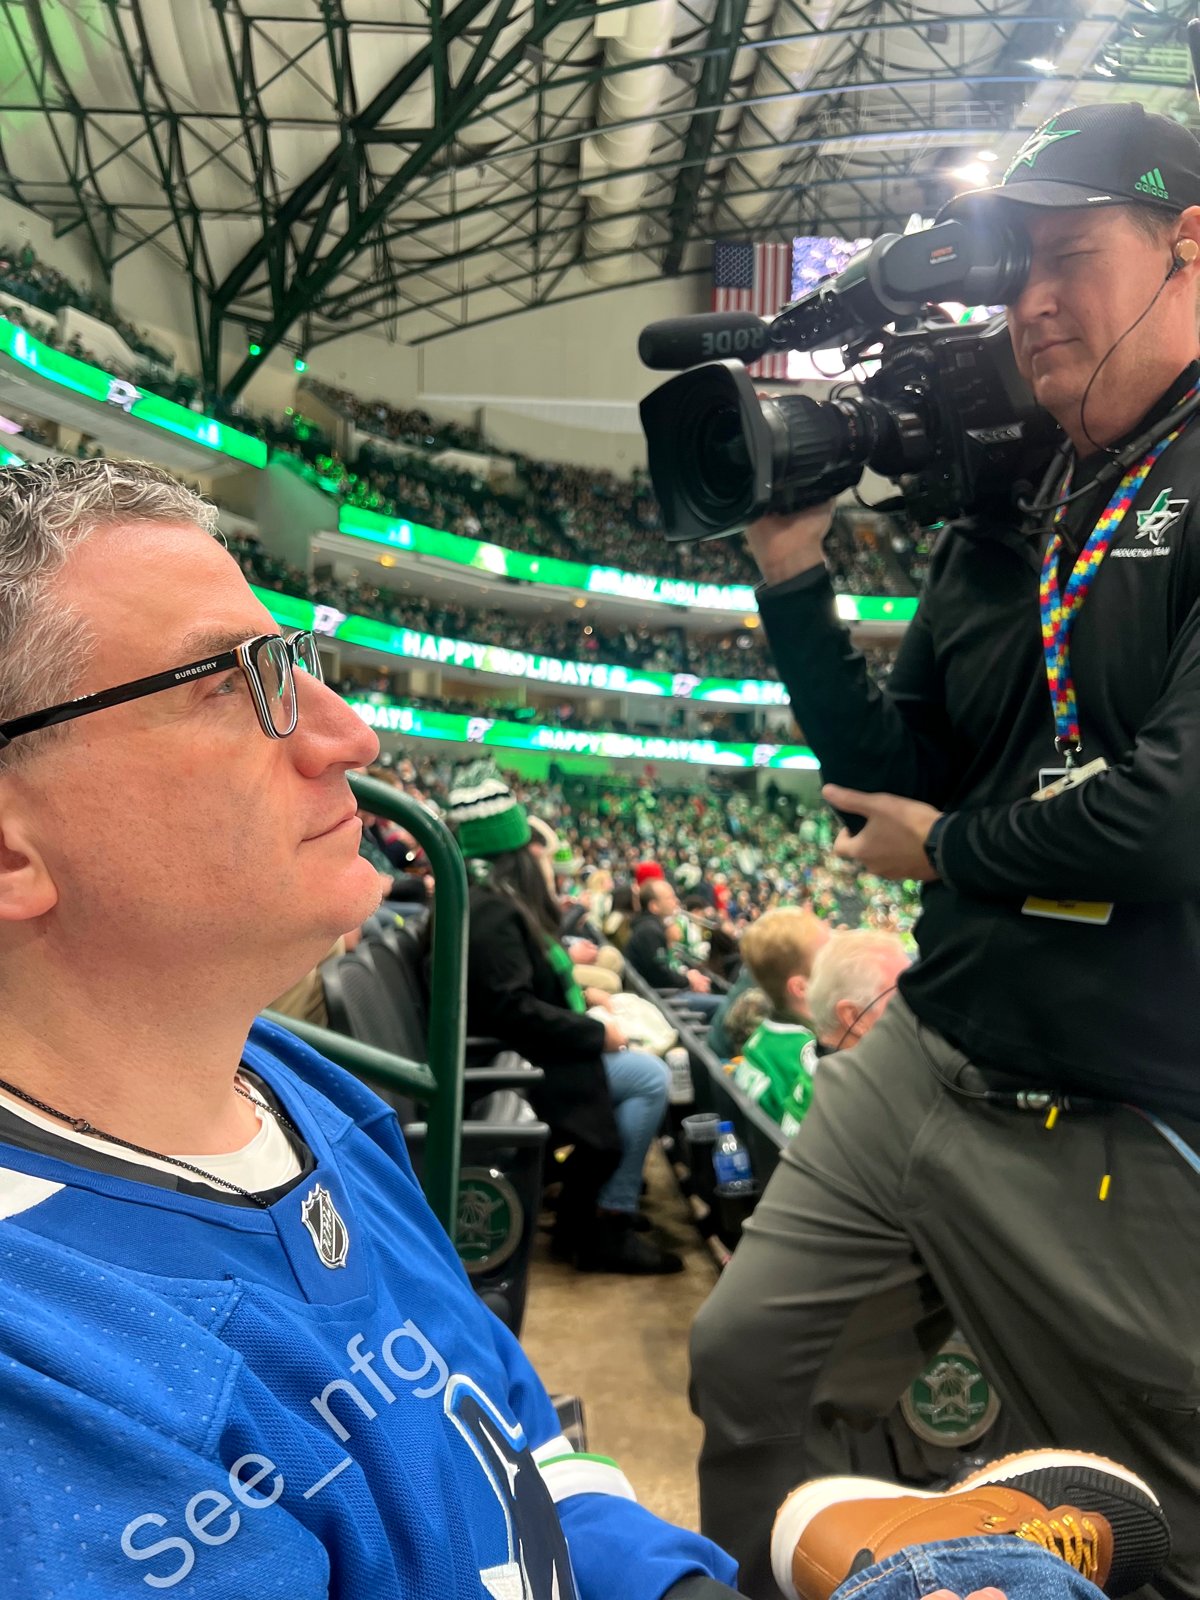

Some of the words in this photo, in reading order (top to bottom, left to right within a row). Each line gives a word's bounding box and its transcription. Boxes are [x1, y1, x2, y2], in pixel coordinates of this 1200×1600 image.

[1134, 181, 1169, 200] adidas
[403, 632, 486, 669] HAPPY
[174, 661, 217, 680] BURBERRY
